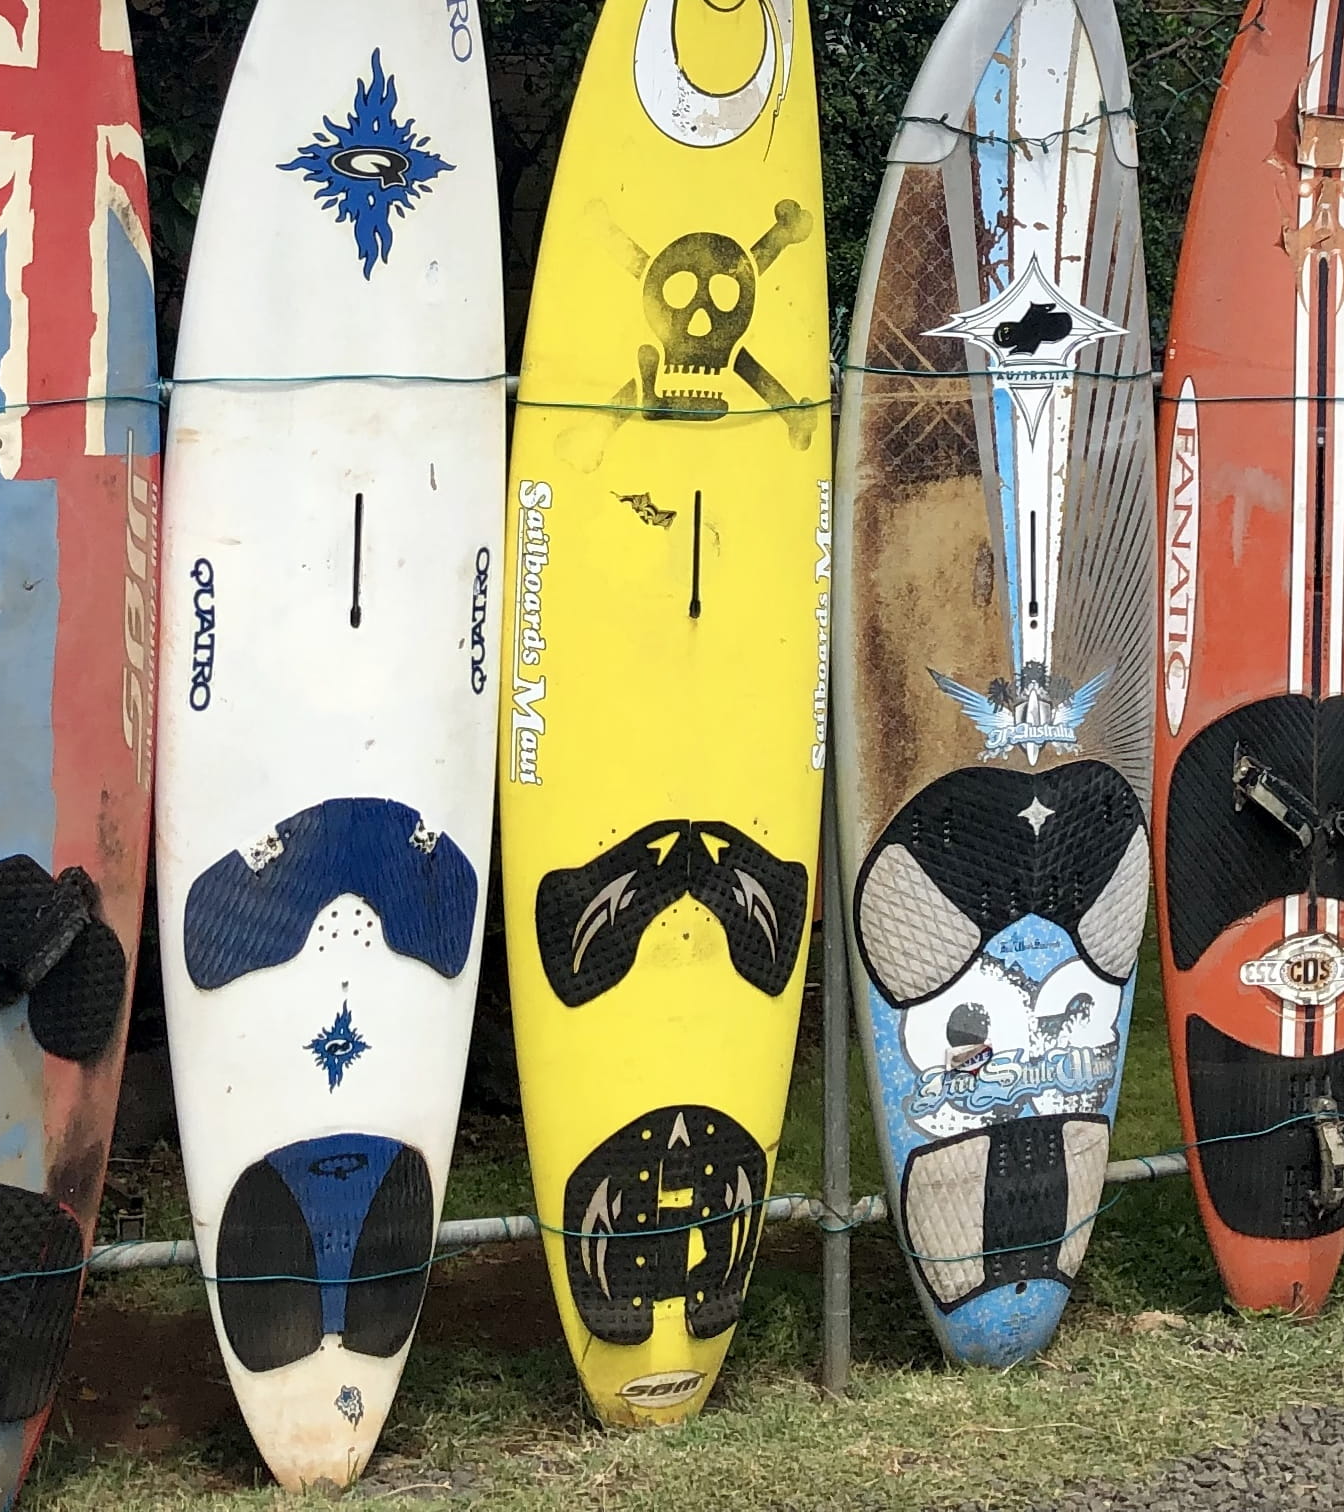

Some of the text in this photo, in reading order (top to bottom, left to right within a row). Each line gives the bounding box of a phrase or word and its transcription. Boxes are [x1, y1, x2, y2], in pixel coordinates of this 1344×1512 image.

[189, 557, 217, 713] QUATRO
[470, 546, 491, 696] QUATRO
[512, 479, 553, 786] Sailboards Maui
[810, 479, 833, 772] Sailboards Maui
[1167, 427, 1196, 690] FANATIC
[1013, 723, 1077, 744] Australia
[1290, 957, 1330, 985] CDS
